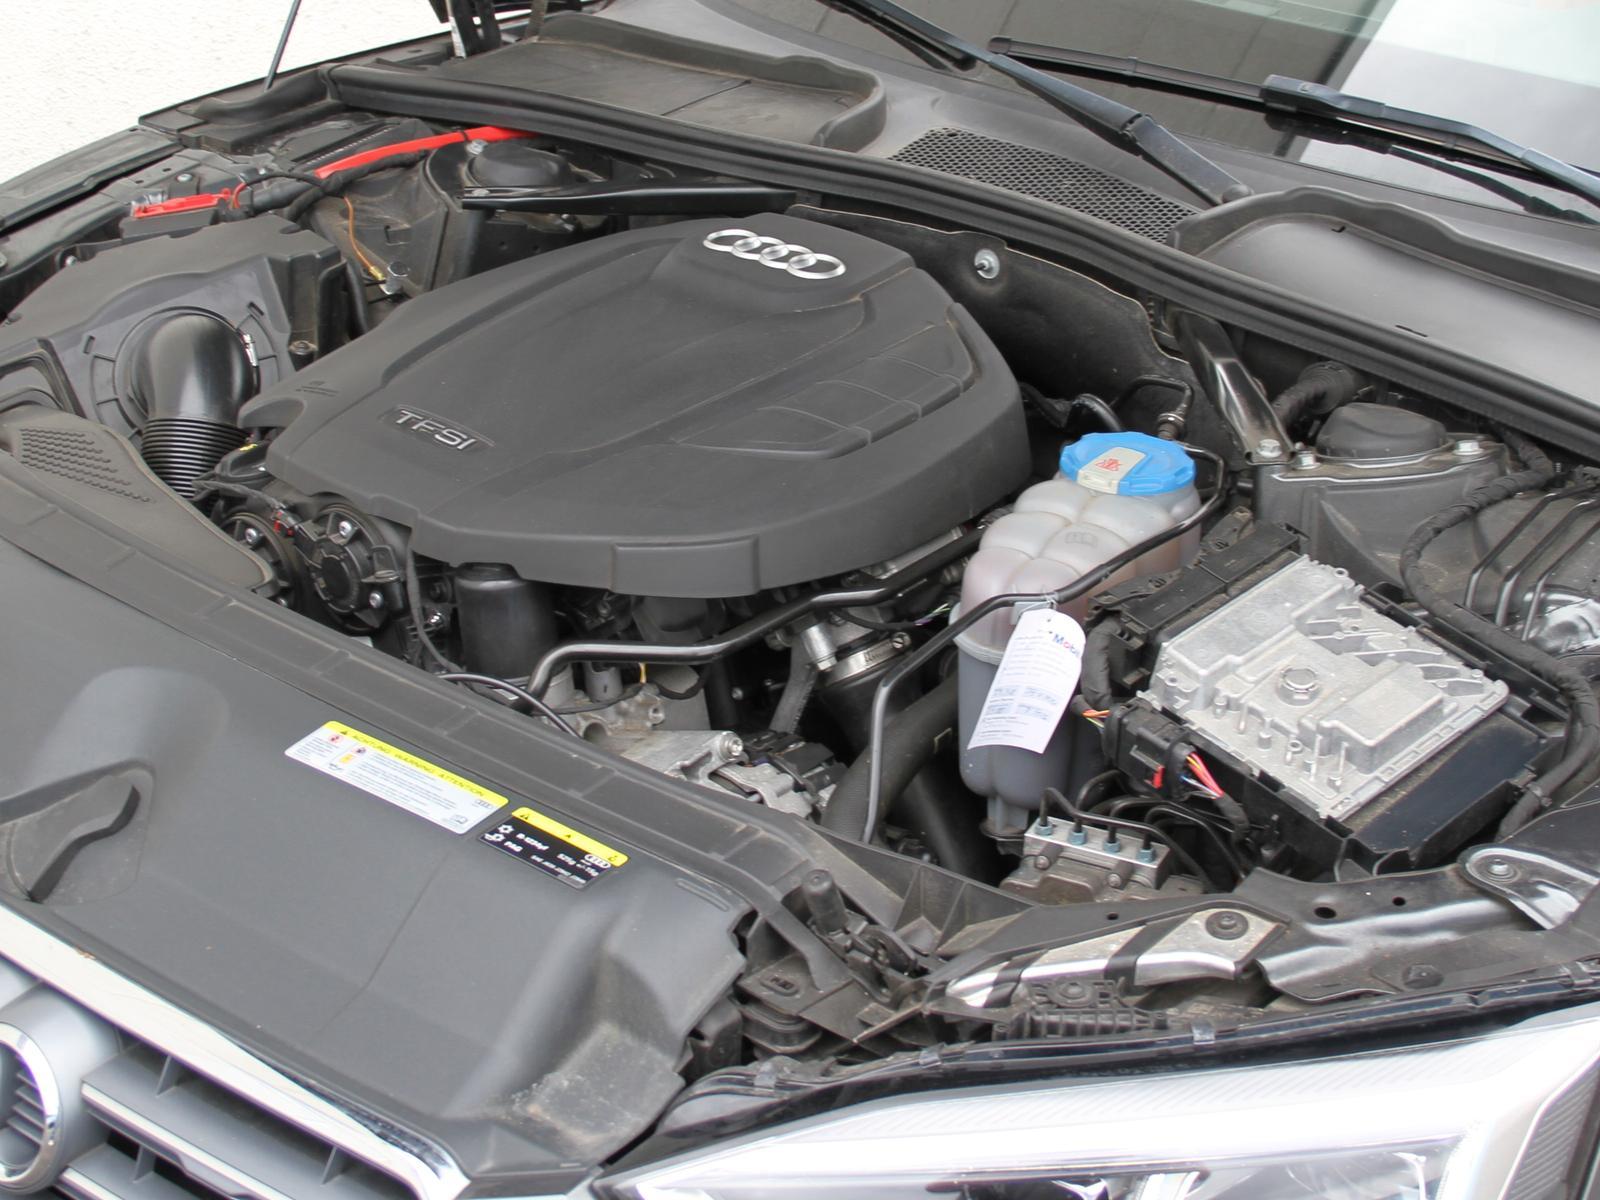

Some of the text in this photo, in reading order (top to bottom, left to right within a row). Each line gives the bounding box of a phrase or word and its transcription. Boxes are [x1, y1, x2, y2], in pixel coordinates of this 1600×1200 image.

[395, 409, 477, 450] TFSI
[395, 753, 438, 775] WARNING
[439, 773, 485, 798] ATTENTION
